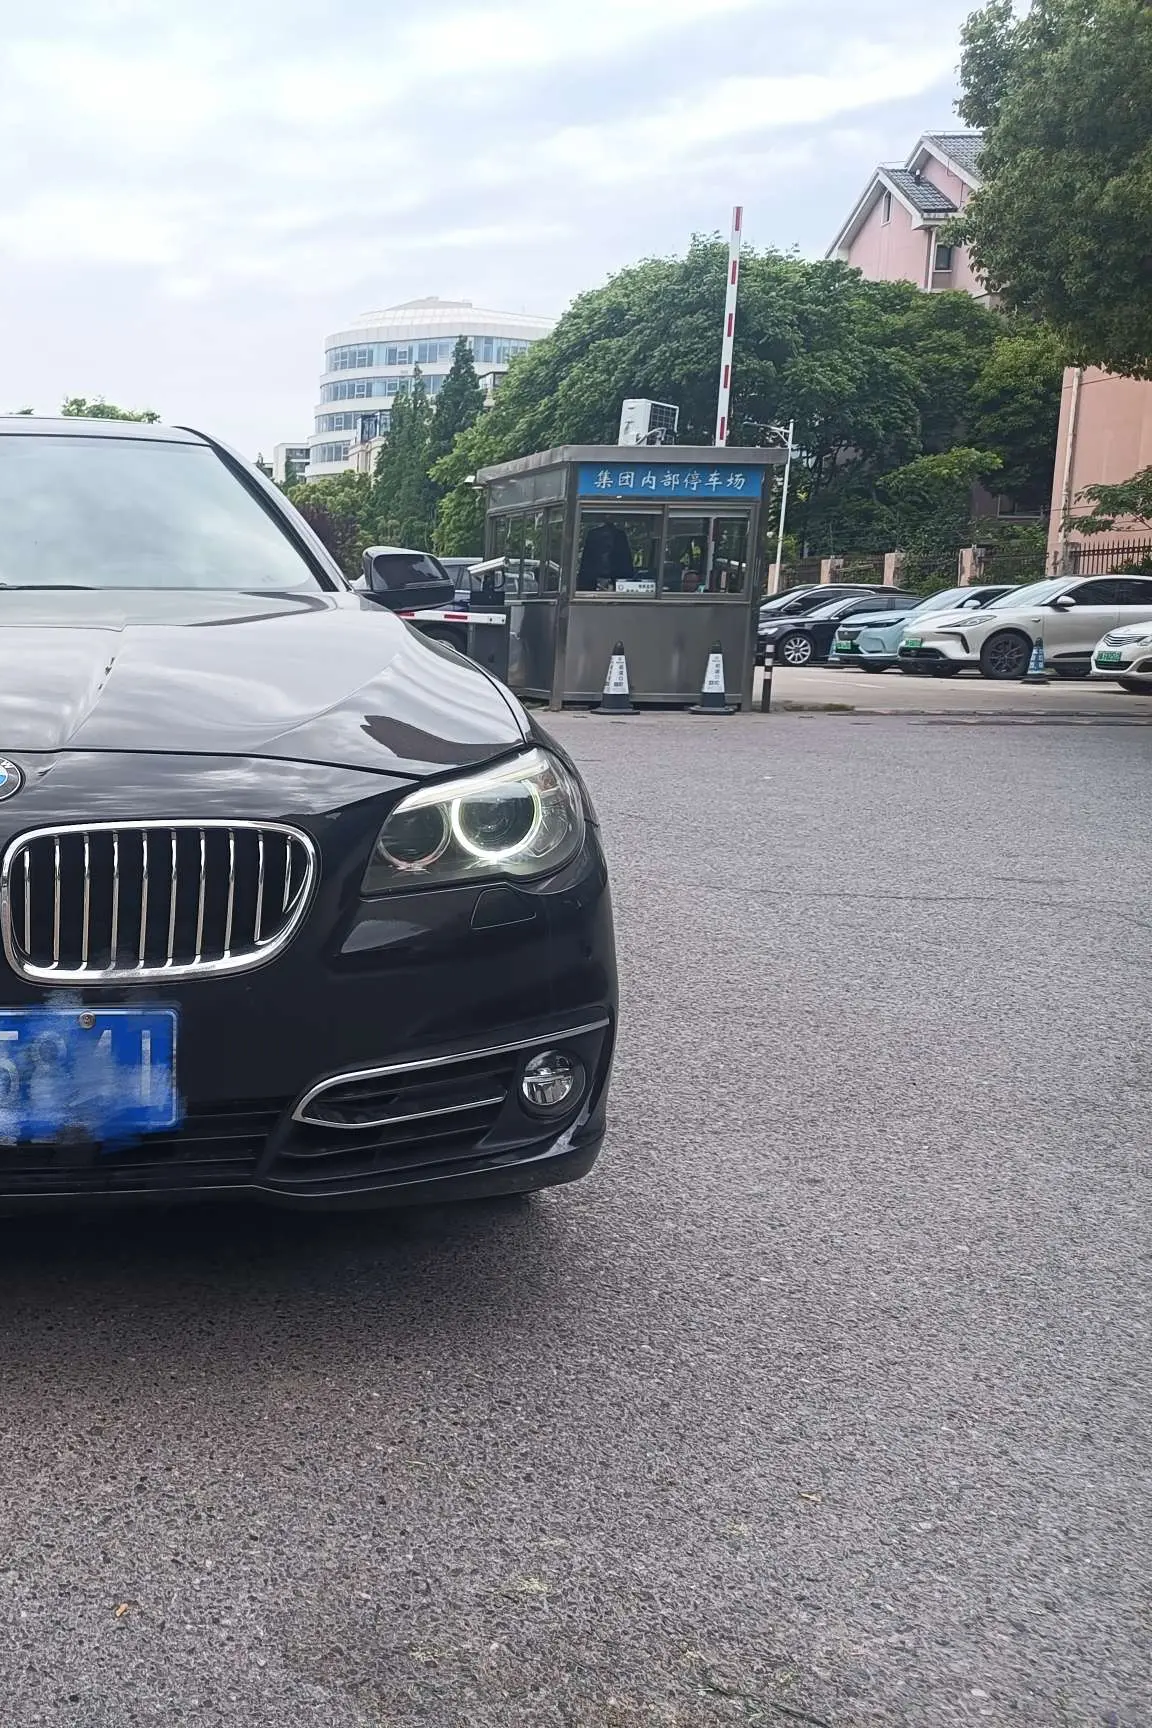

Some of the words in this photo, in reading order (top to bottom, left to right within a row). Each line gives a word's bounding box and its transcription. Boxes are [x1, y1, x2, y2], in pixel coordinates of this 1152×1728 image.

[594, 469, 746, 492] 集团内部停车场
